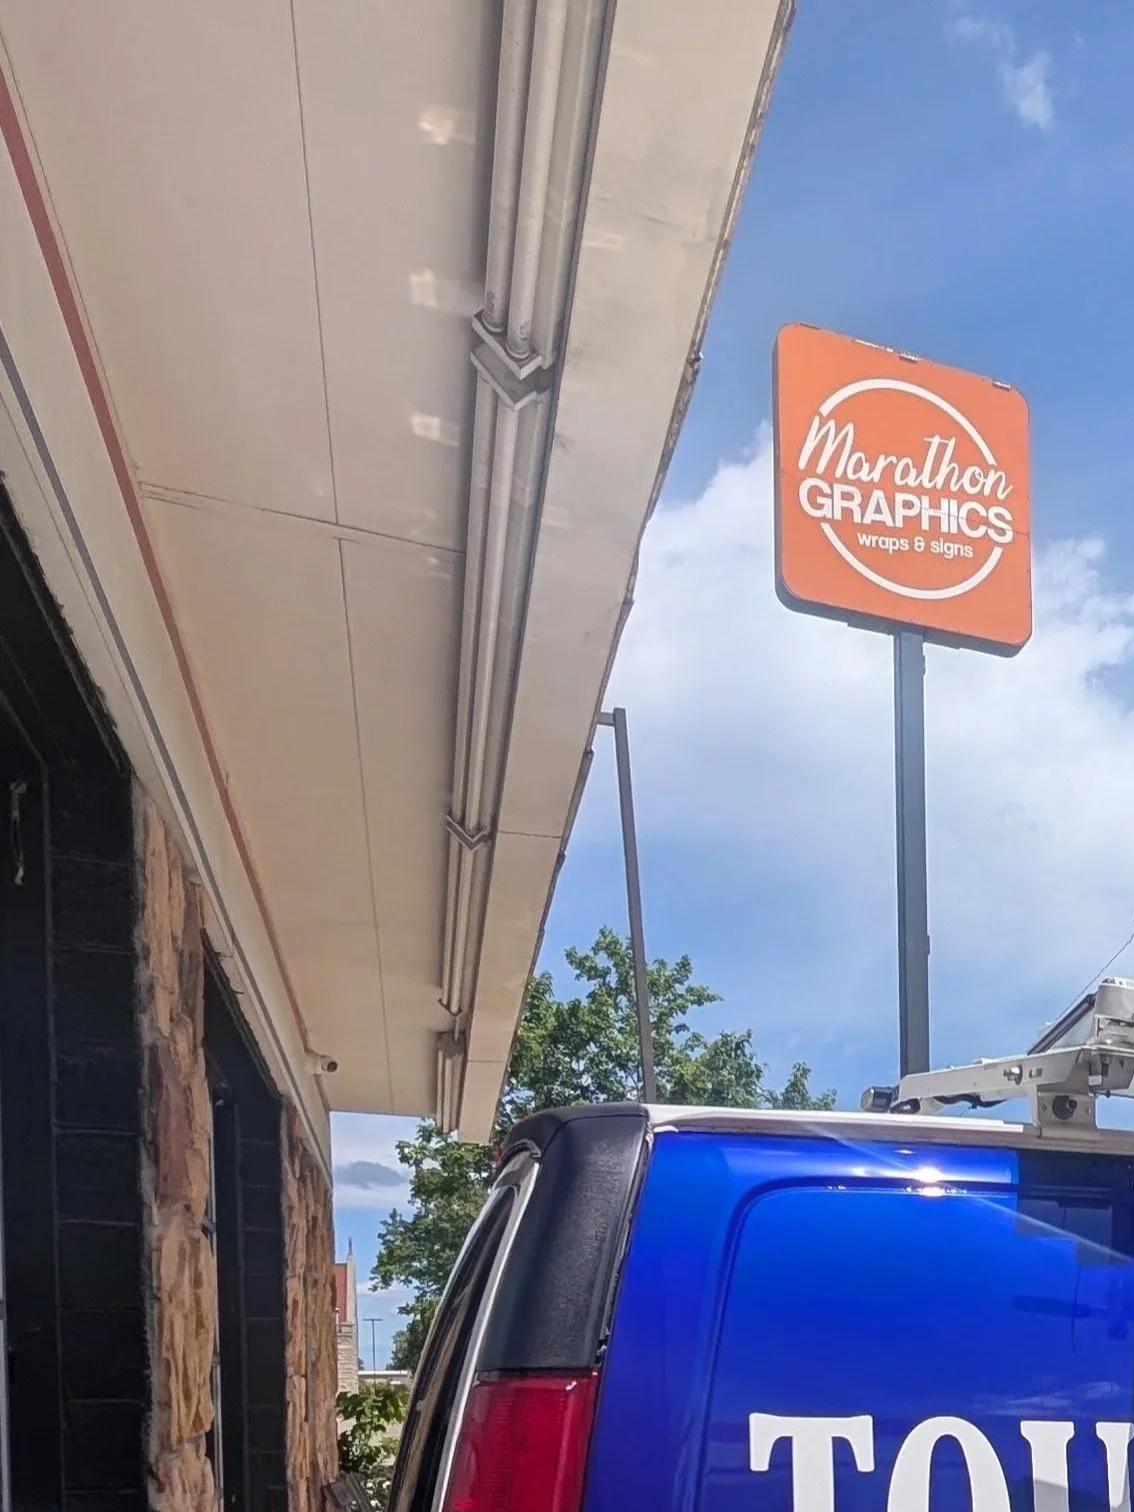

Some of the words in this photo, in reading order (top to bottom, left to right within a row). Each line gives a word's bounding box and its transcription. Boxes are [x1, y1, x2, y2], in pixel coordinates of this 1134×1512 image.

[797, 414, 1014, 501] Marathon
[799, 476, 1014, 544] GRAPHICS
[856, 530, 910, 555] wraps
[913, 535, 926, 553] &
[929, 536, 975, 560] signs
